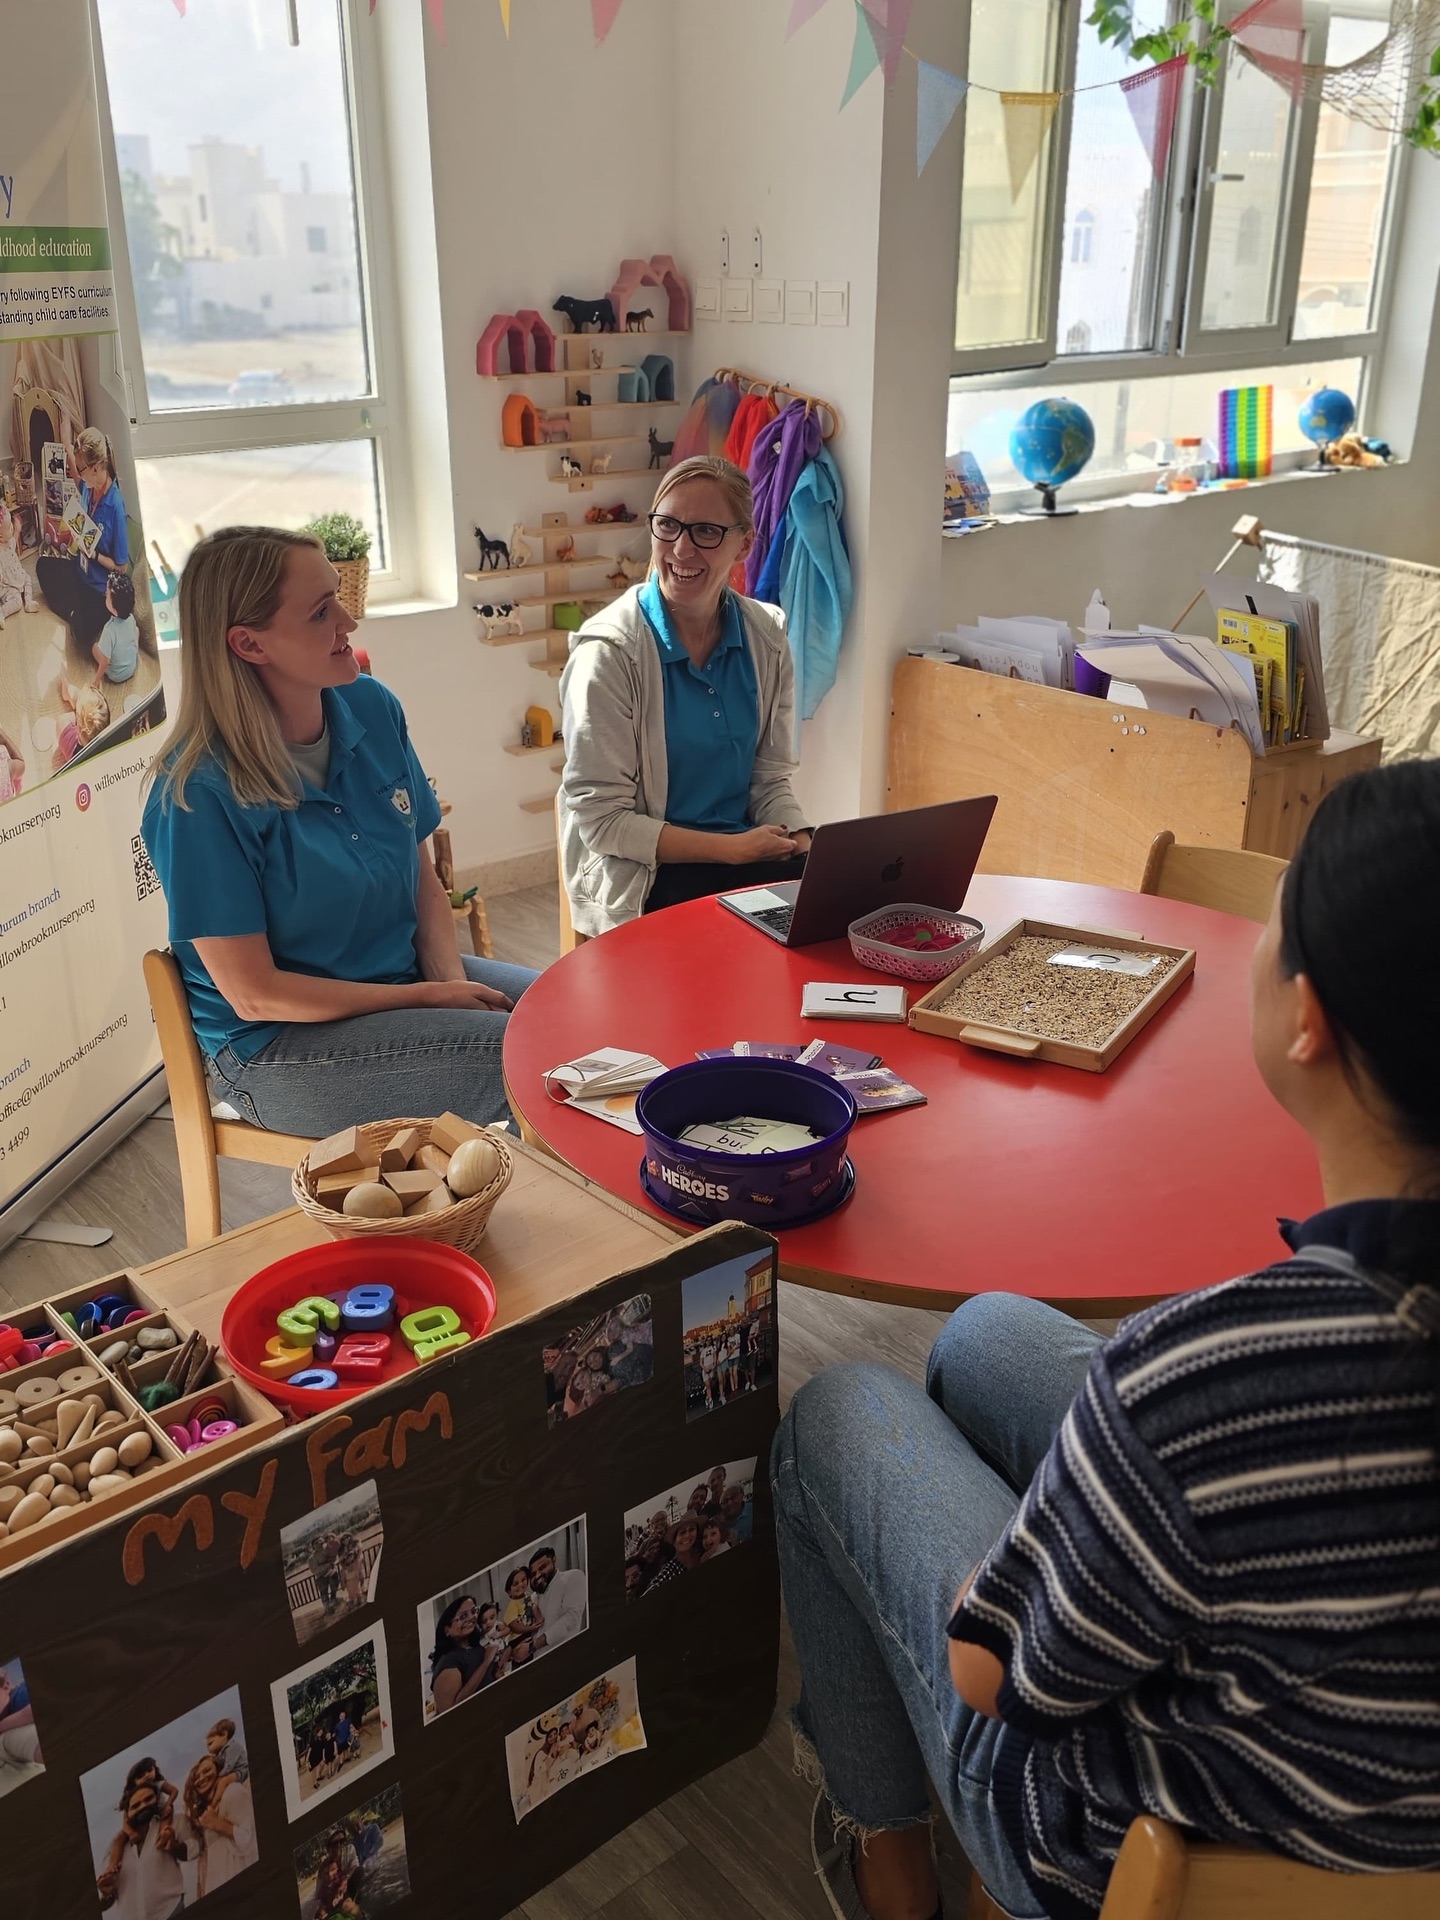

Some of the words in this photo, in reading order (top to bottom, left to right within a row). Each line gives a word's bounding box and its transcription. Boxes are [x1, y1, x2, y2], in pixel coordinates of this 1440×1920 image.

[40, 238, 92, 257] education
[10, 287, 50, 303] following
[51, 286, 76, 300] EYFS
[35, 308, 57, 321] child
[59, 308, 77, 320] care
[28, 887, 61, 916] branch
[8, 1126, 30, 1153] 4499
[661, 1164, 730, 1202] HEROES
[676, 1164, 707, 1184] Cadbury
